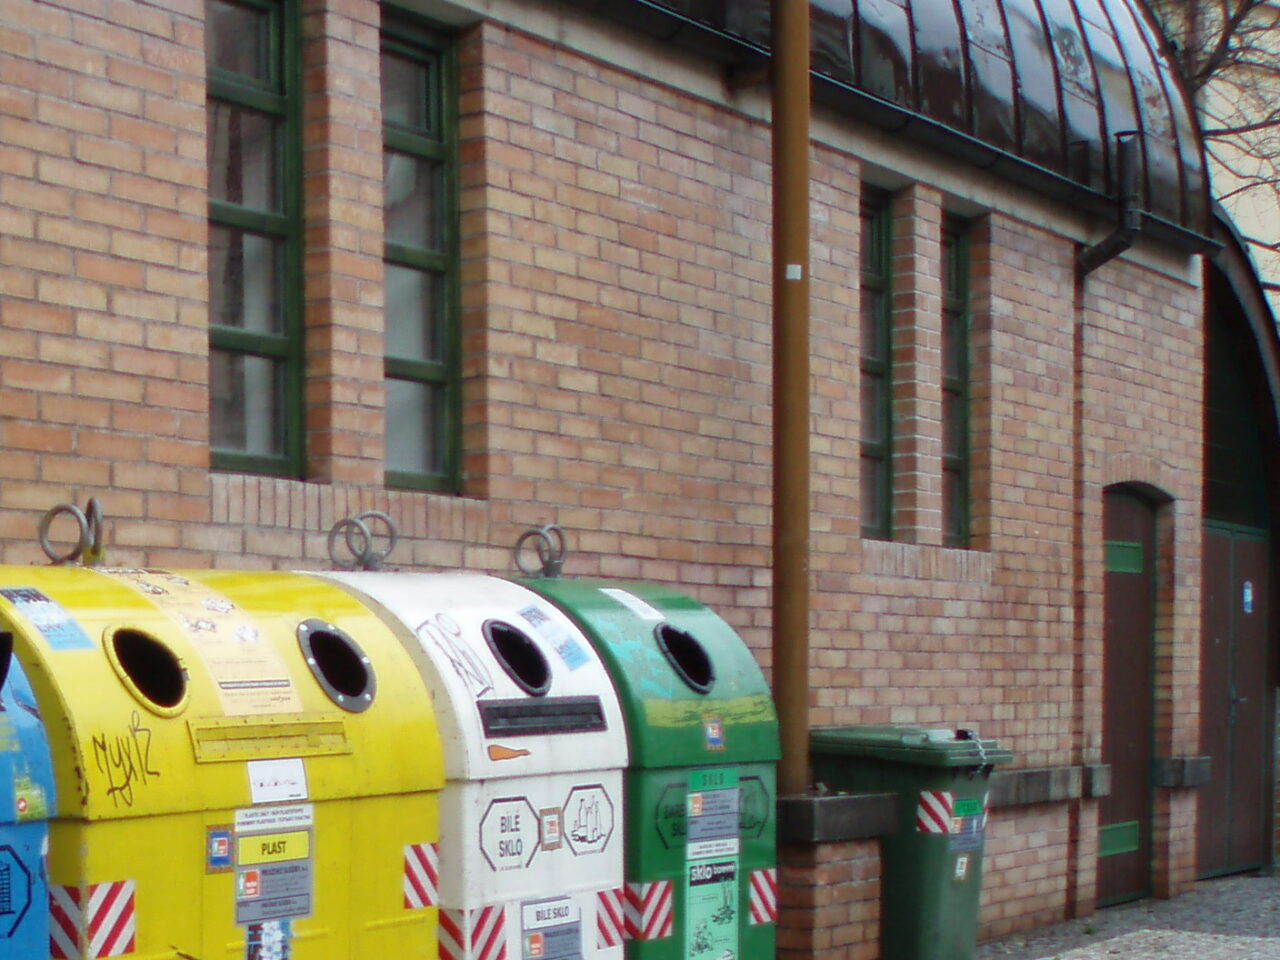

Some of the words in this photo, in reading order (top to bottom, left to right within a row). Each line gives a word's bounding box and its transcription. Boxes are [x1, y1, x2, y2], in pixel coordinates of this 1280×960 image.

[261, 841, 286, 855] PLAST
[499, 838, 523, 857] SKLO
[691, 865, 712, 881] sklo
[553, 905, 570, 919] SKLO
